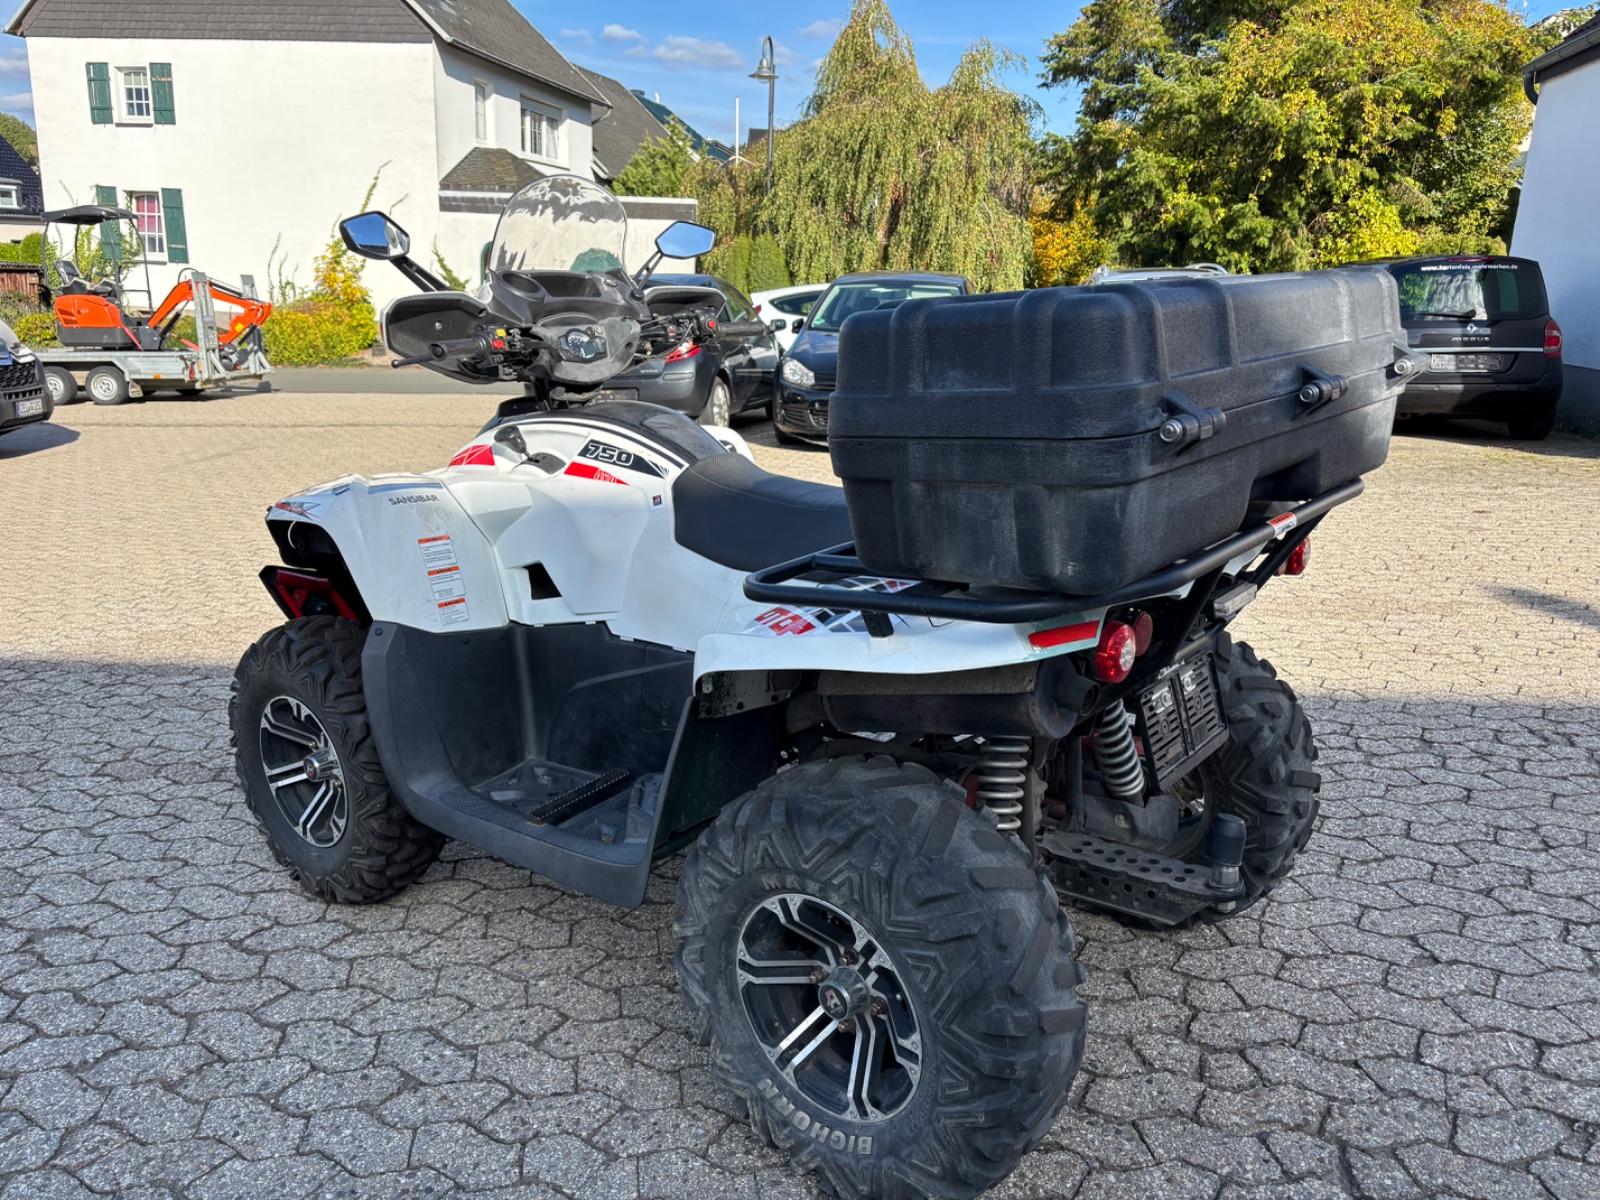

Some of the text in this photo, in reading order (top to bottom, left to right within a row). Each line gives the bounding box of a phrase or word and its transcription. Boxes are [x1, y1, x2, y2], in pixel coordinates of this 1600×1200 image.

[586, 443, 633, 466] 750
[388, 495, 439, 505] SANSIBAR
[757, 1078, 872, 1155] BIGHORN
